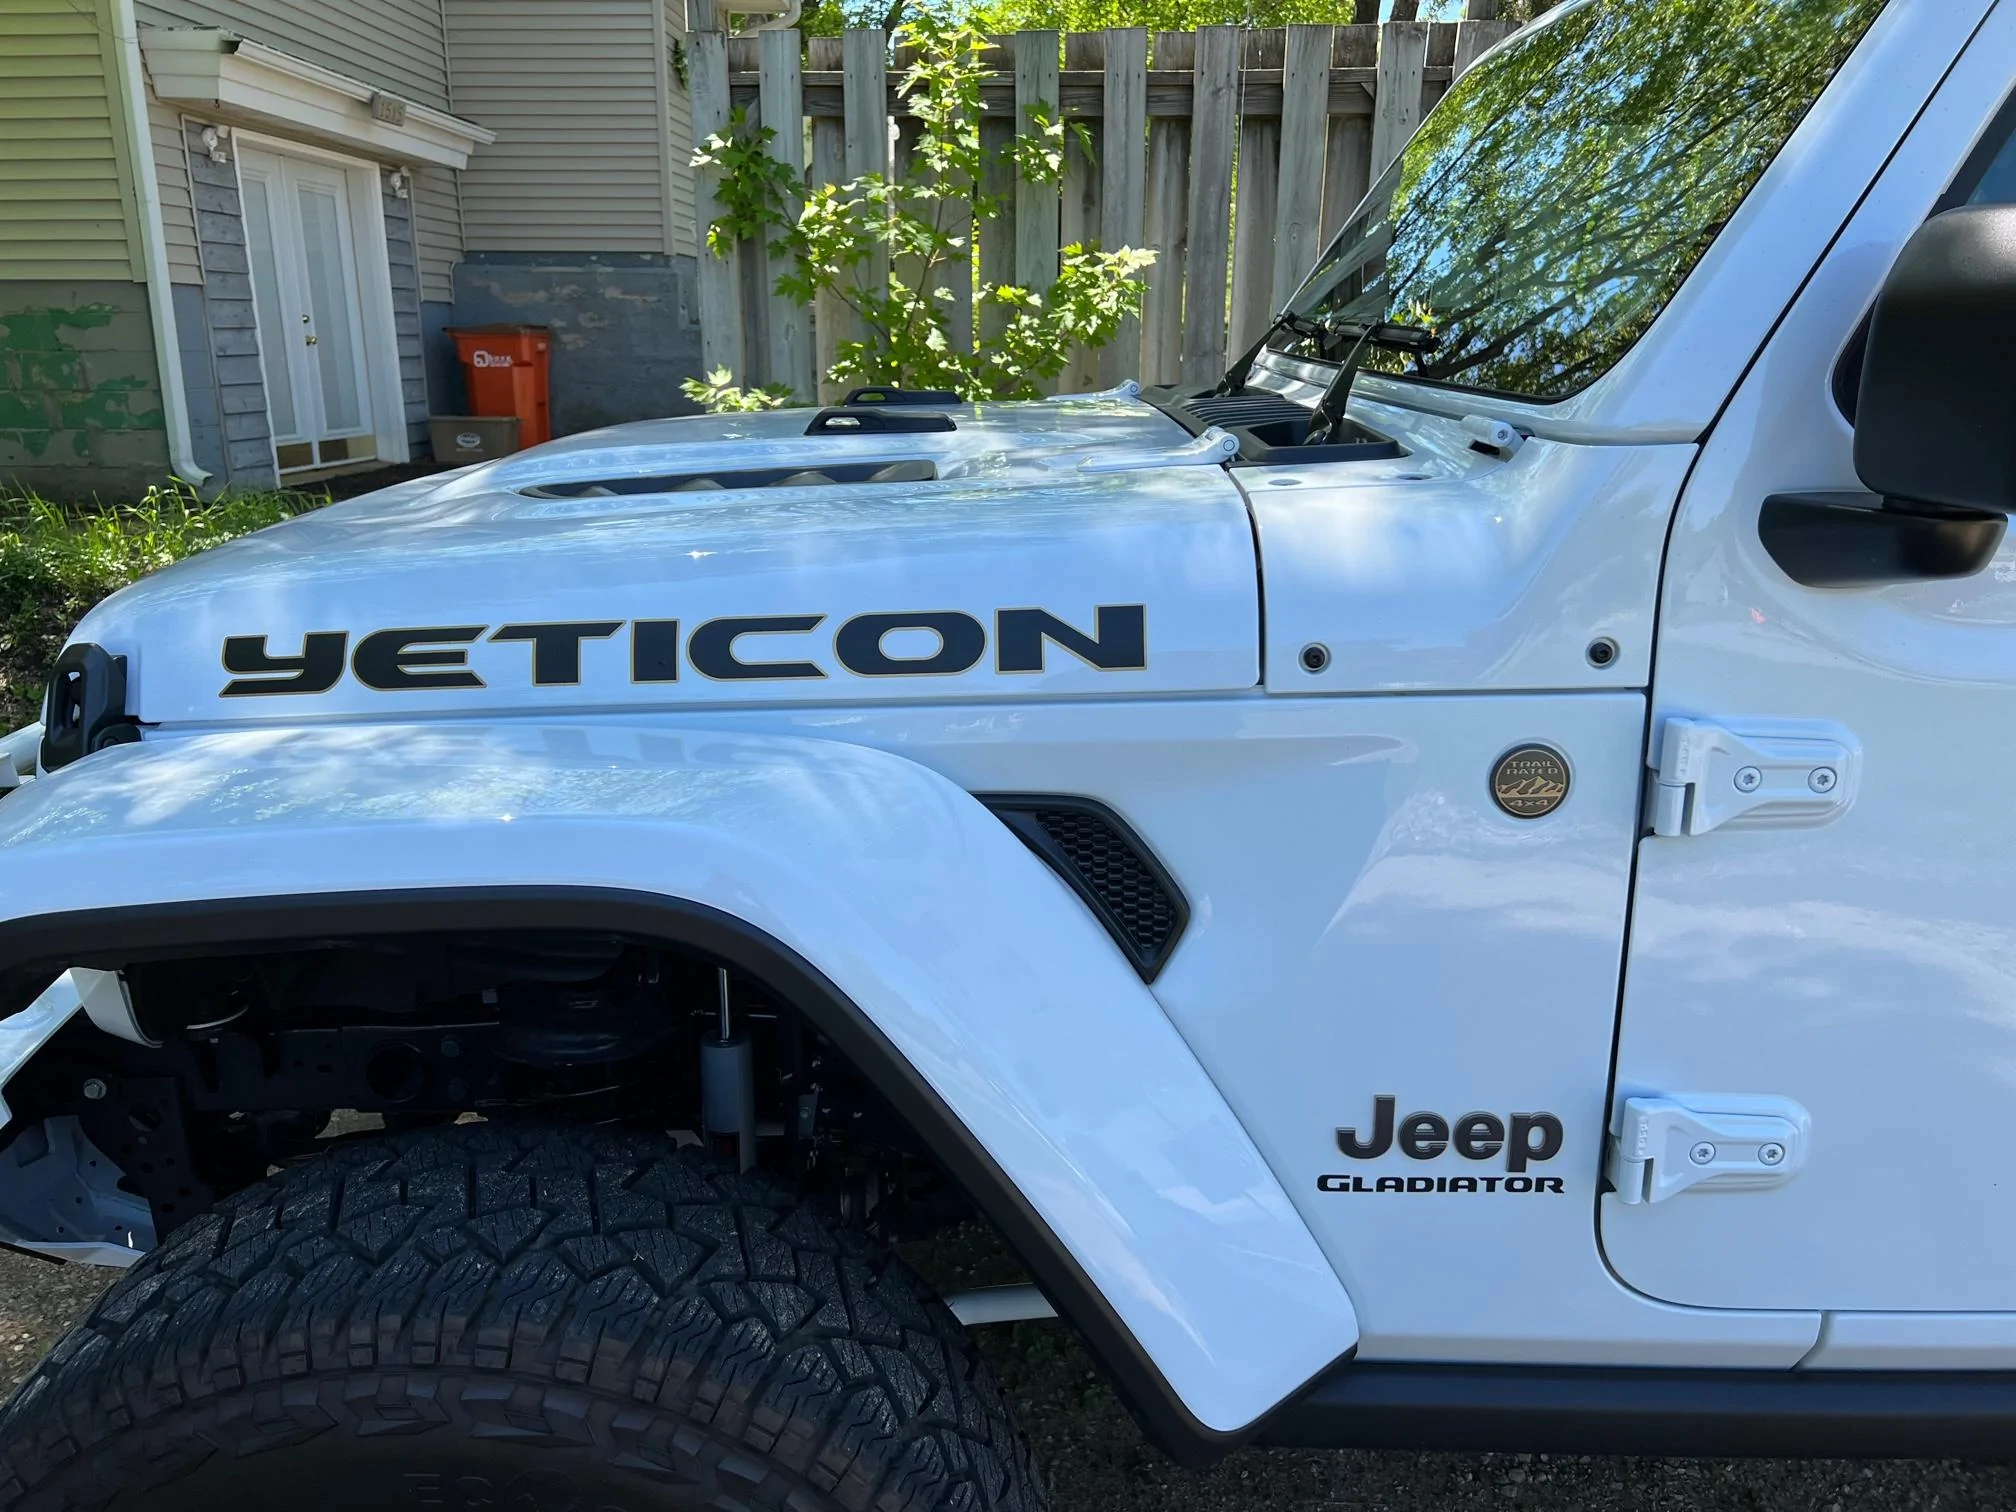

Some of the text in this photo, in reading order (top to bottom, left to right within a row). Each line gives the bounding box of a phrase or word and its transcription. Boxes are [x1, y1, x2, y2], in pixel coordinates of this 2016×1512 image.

[219, 603, 1147, 697] YETICON
[1506, 767, 1558, 775] RATED
[1511, 760, 1553, 768] TRAIL
[1336, 1095, 1563, 1173] Jeep
[1317, 1174, 1565, 1194] GLADIATOR
